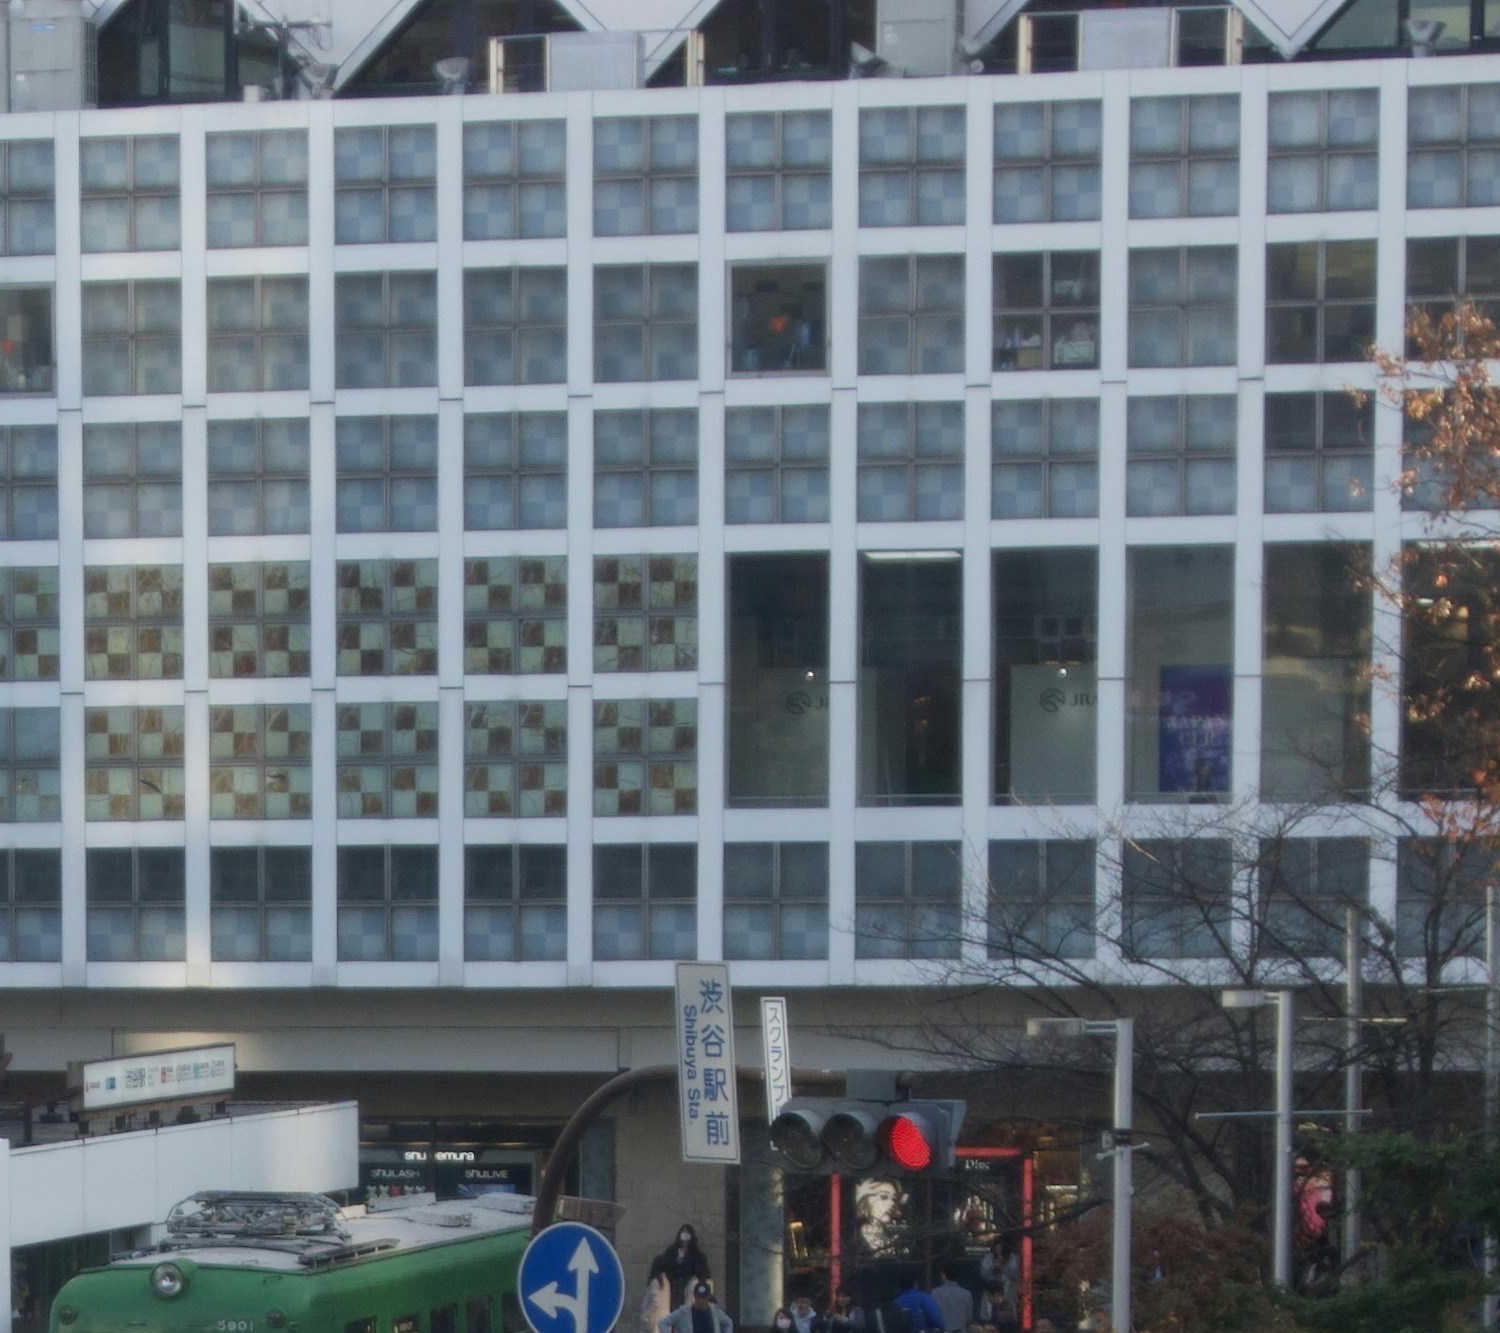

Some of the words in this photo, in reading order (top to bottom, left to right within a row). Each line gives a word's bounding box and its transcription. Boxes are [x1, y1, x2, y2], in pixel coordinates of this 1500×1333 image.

[684, 1004, 698, 1080] Shibuya
[700, 979, 730, 1145] 渋谷駅前
[688, 1087, 701, 1126] Sta.
[434, 1151, 475, 1161] emura
[216, 1319, 254, 1331] 5001
